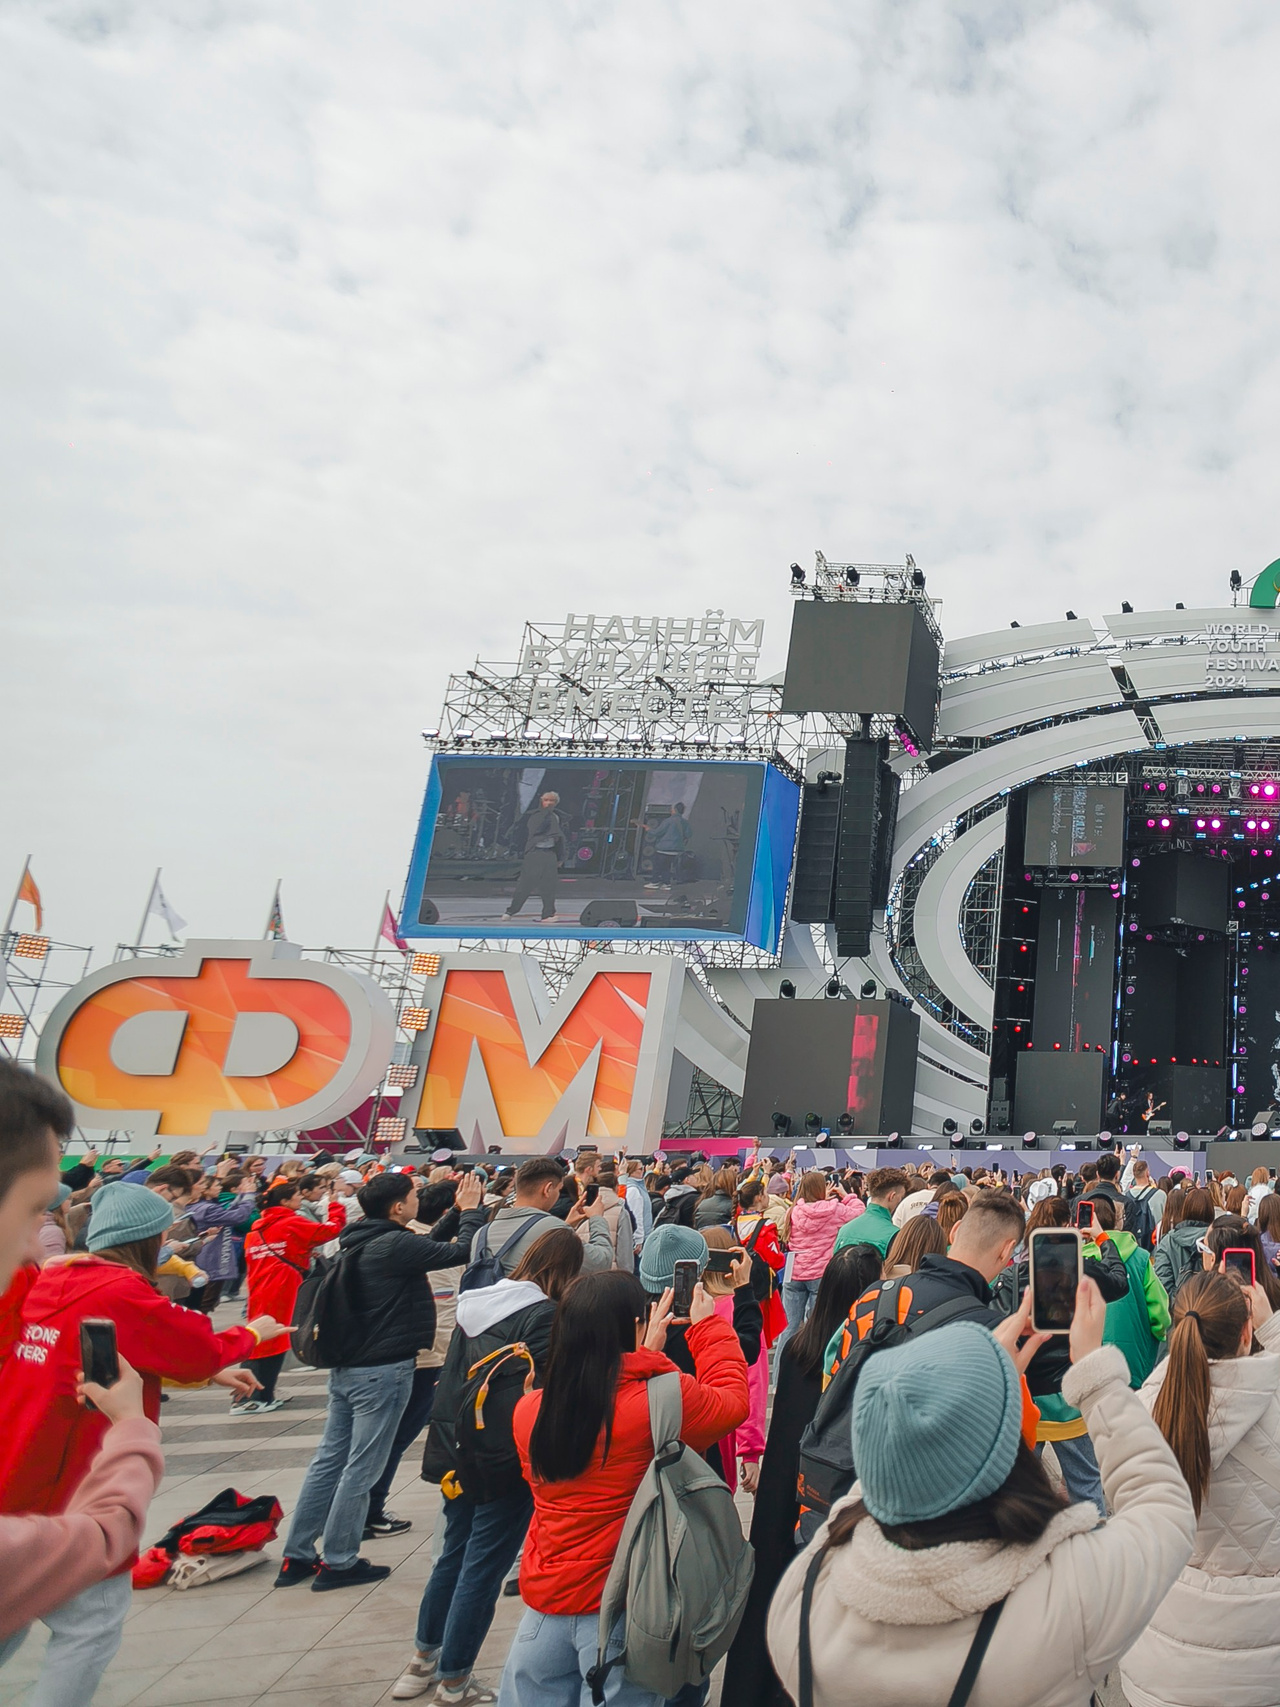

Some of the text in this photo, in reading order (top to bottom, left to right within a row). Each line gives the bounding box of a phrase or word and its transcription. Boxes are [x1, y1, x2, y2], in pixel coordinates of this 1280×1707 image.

[562, 609, 765, 647] НАЧНЁМ
[1205, 623, 1270, 635] WORLD
[1206, 640, 1267, 653] YOUTH
[521, 645, 760, 685] БУДУЩЕЕ
[1205, 675, 1247, 688] 2024
[529, 686, 750, 725] ВМЕСТЕ!
